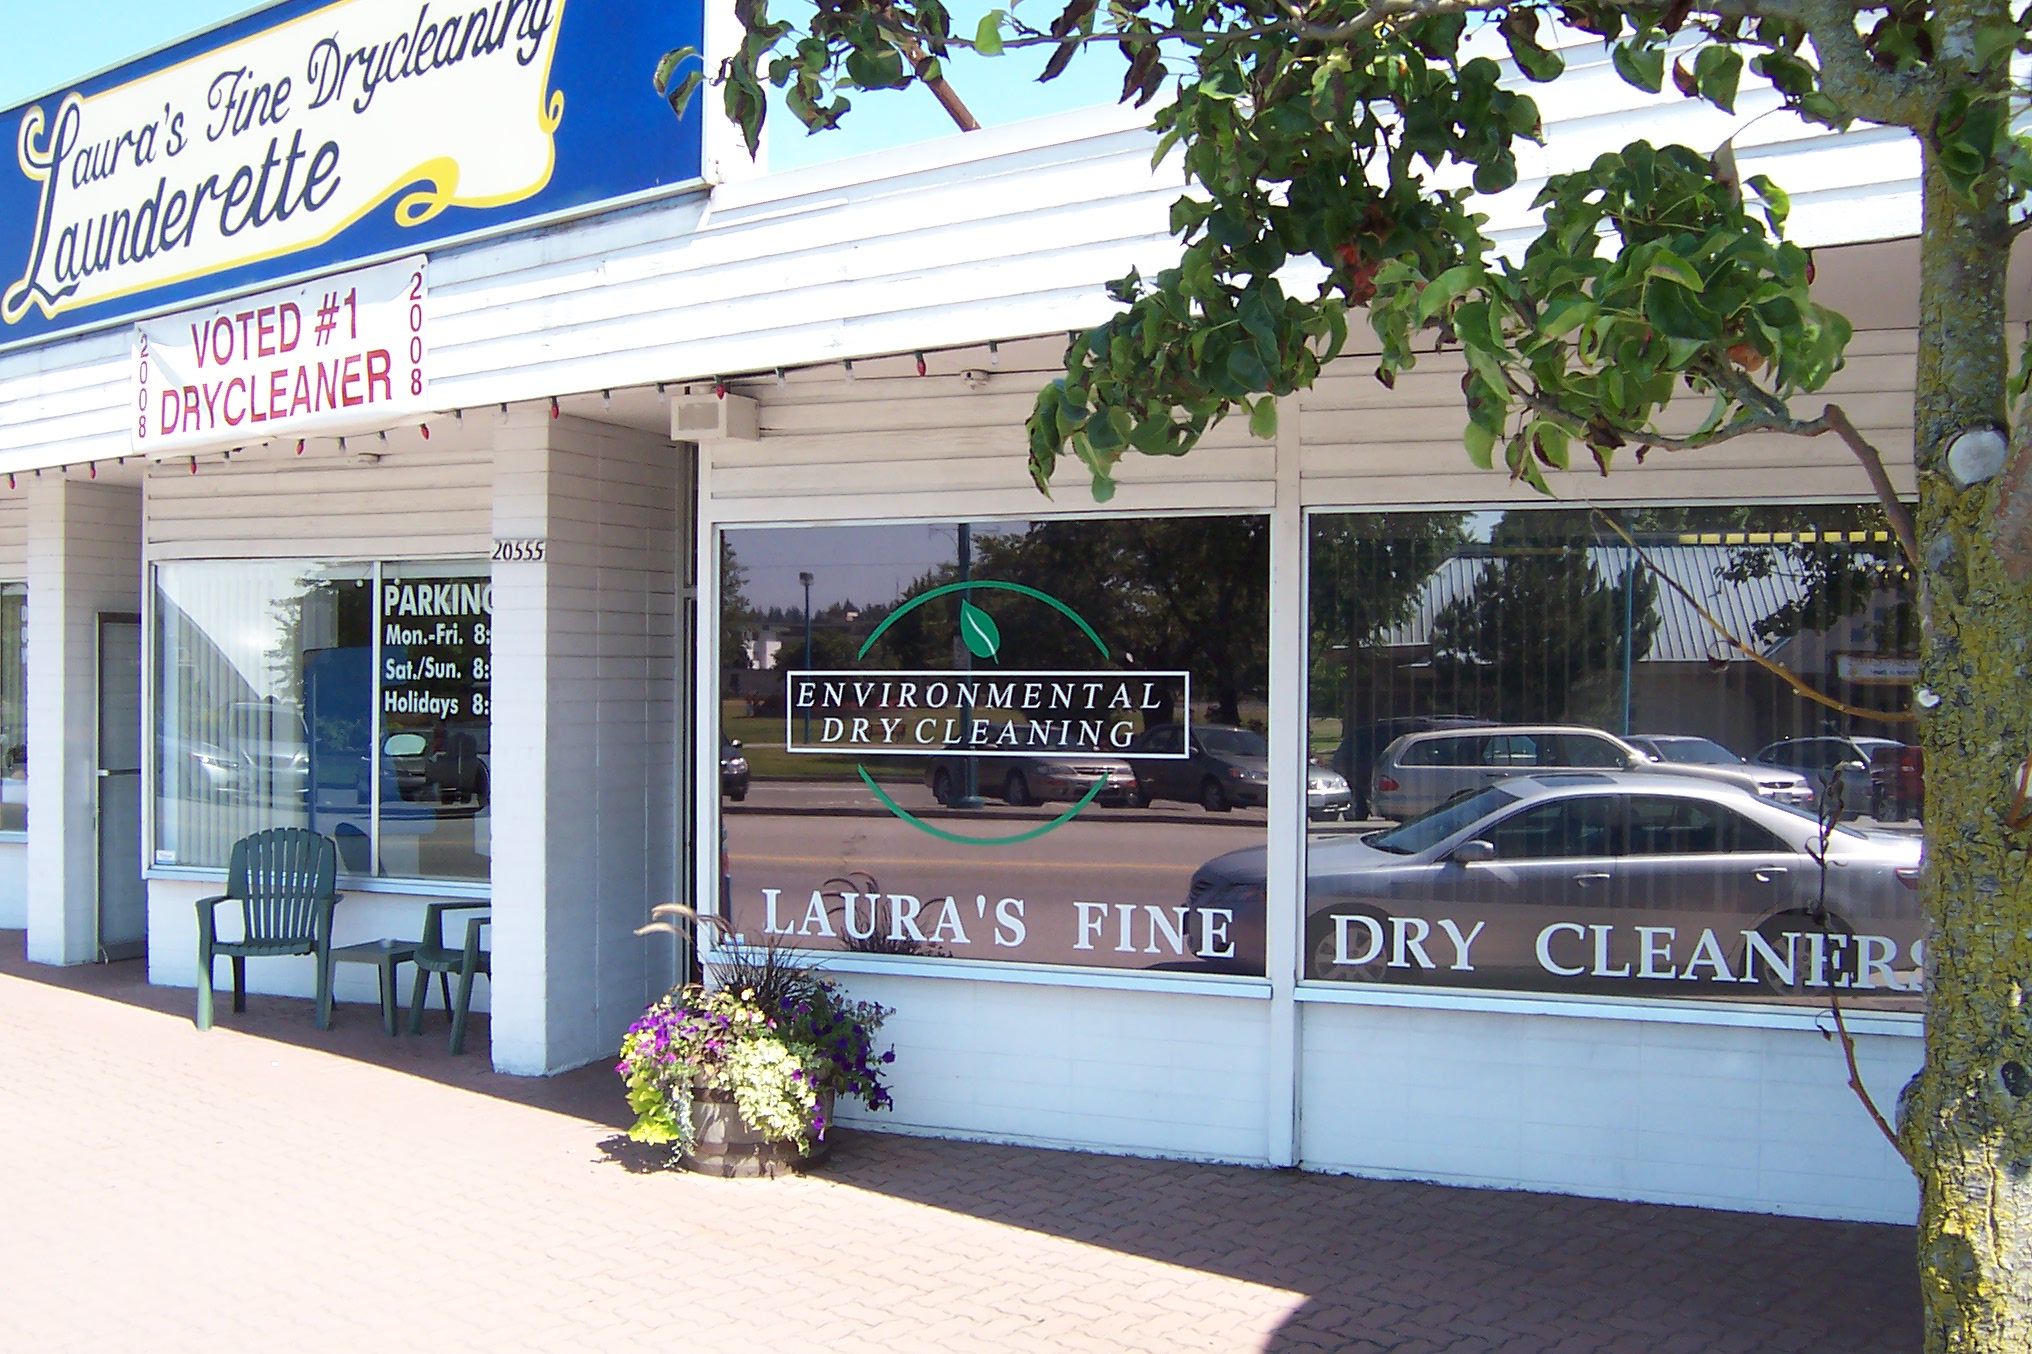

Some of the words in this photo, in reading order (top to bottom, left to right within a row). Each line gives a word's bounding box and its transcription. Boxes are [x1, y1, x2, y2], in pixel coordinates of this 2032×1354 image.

[24, 102, 188, 190] Laura's
[207, 65, 292, 142] Fine
[307, 0, 554, 114] Drycleaning
[8, 128, 341, 312] Launderette
[191, 302, 301, 368] VOTED
[315, 287, 357, 346] #1
[411, 271, 423, 396] 2008
[161, 349, 392, 435] DRYCLEANER
[492, 541, 545, 561] 20555
[385, 622, 464, 646] Mon.-Fri.
[385, 655, 462, 681] Sat./Sun.
[796, 681, 1163, 711] ENVIRONMENTAL
[384, 690, 459, 719] Holidays
[820, 717, 904, 744] DRY
[914, 717, 1136, 749] CLEANING
[760, 887, 1028, 948] LAURA'S
[1072, 900, 1236, 959] FINE
[1329, 912, 1486, 972] DRY
